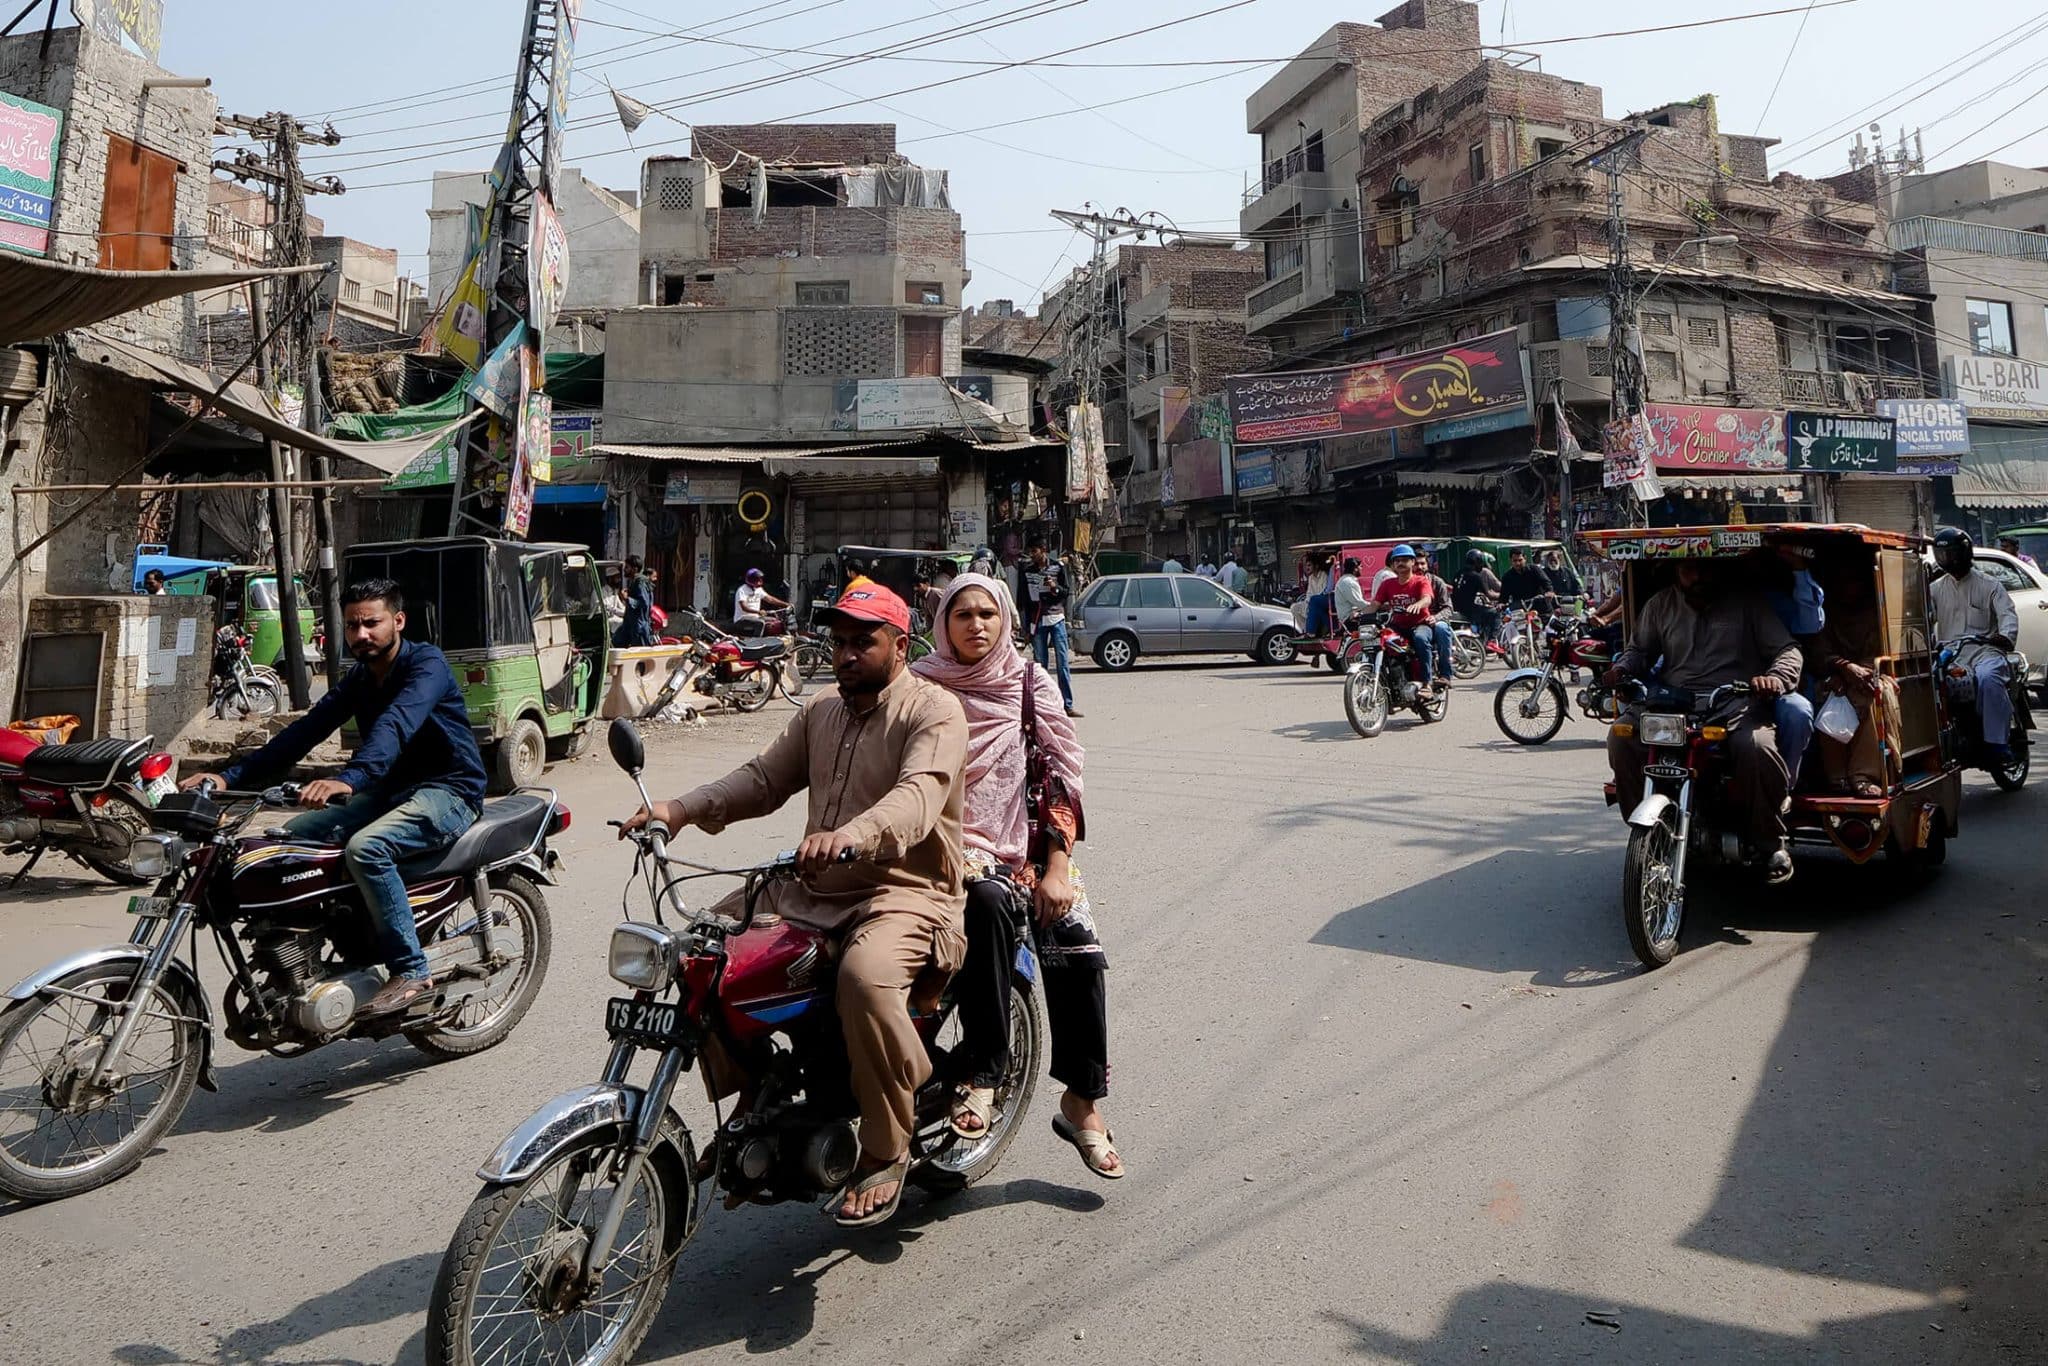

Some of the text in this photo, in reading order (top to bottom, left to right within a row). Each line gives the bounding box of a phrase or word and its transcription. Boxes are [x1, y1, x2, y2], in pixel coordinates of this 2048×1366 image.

[20, 199, 43, 216] 13-14
[1961, 359, 2039, 389] AL-BARI
[1979, 390, 2027, 404] MEDICOS
[1885, 403, 1962, 427] LAHORE
[1816, 418, 1893, 440] A.P PHARMACY
[1933, 430, 1965, 442] STORE
[1684, 429, 1717, 458] Chill
[282, 867, 324, 884] HONDA
[611, 1002, 675, 1034] TS 2110
